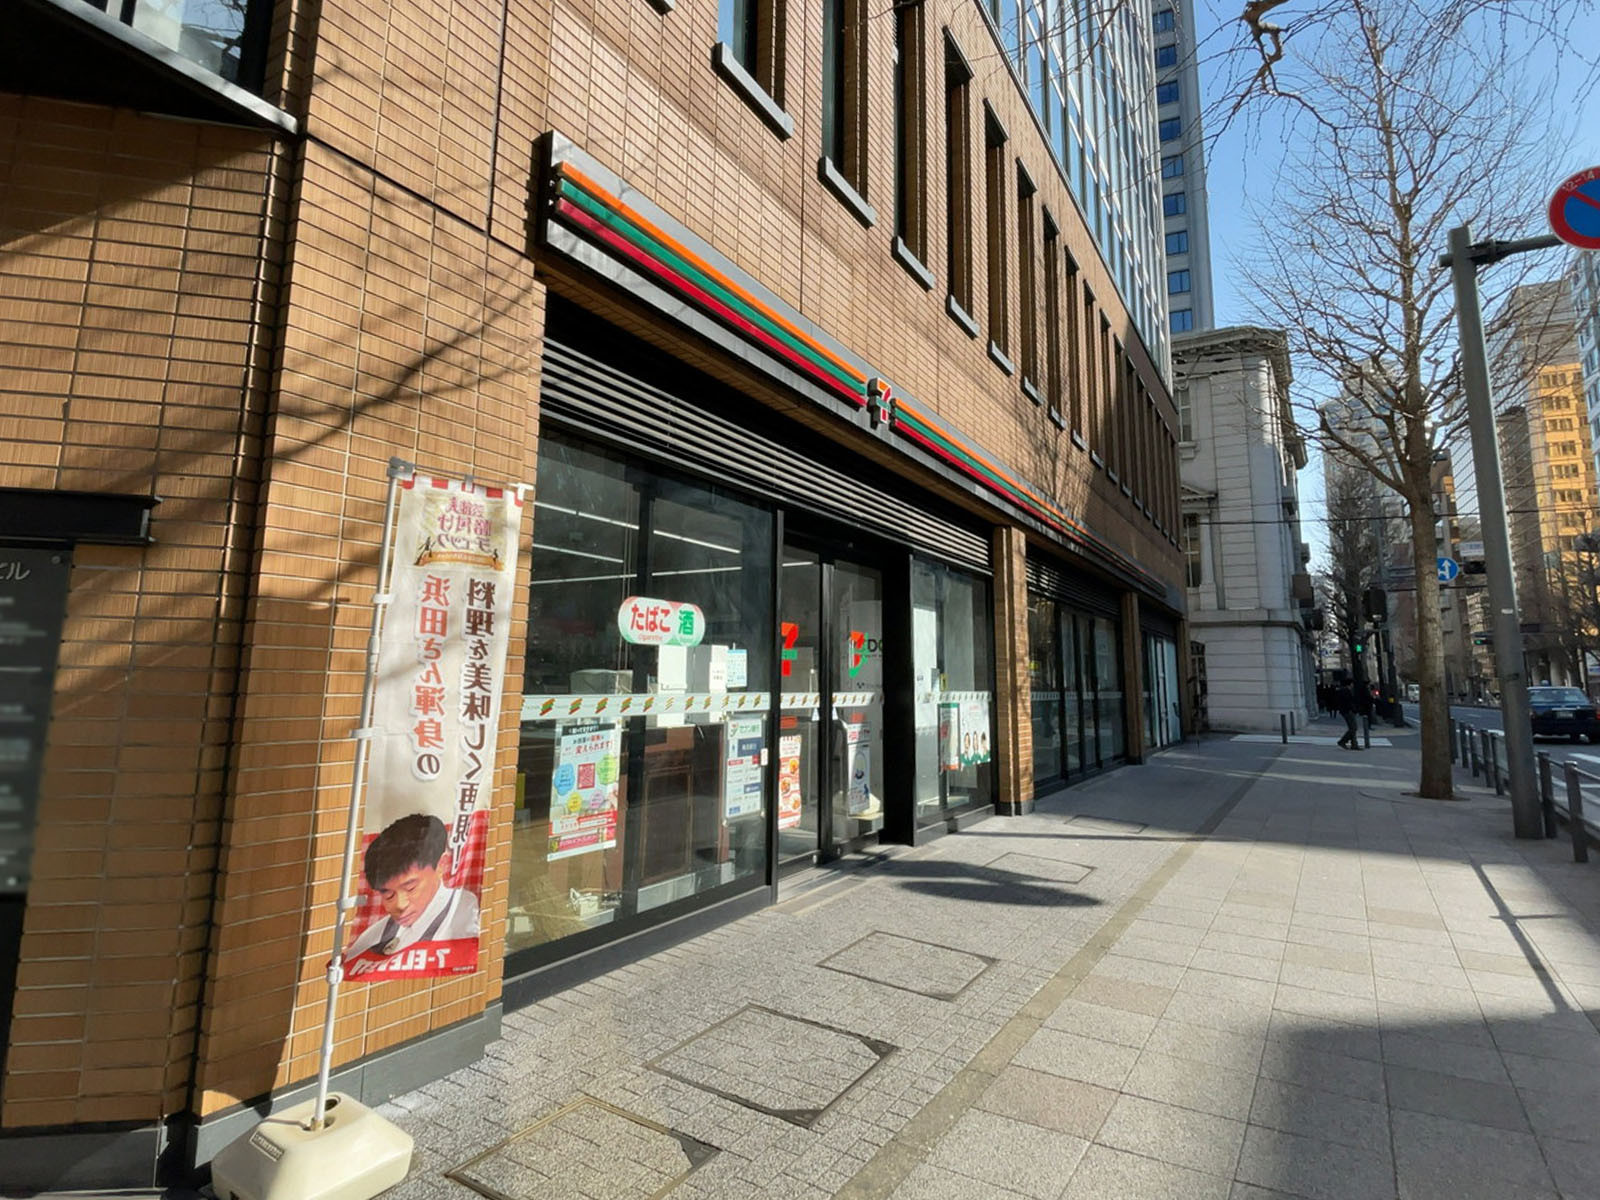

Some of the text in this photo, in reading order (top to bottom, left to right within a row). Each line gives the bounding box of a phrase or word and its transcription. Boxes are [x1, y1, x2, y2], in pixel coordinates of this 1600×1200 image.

[630, 603, 695, 636] たばこ 酒
